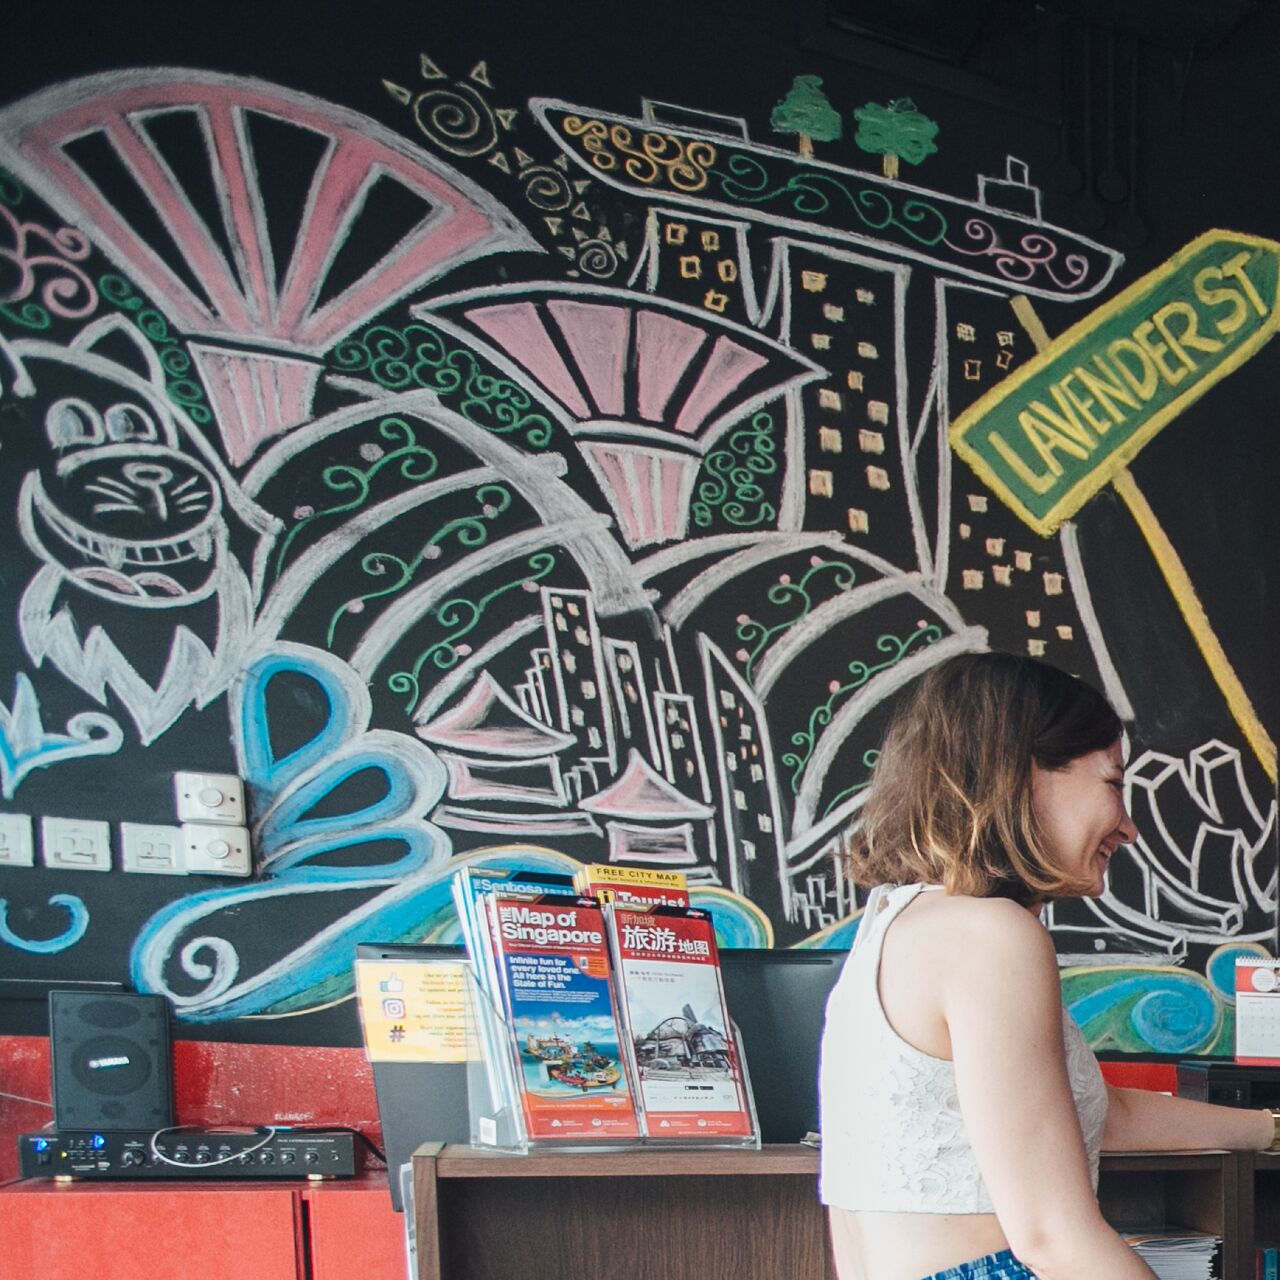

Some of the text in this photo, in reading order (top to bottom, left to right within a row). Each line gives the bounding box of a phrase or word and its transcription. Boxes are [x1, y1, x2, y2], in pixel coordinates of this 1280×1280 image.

[988, 252, 1267, 495] LAVENDER ST
[597, 868, 625, 876] FREE
[629, 871, 652, 879] CITY
[481, 879, 543, 893] Sentosa
[512, 908, 555, 927] Map
[557, 911, 577, 927] of
[502, 923, 602, 945] Singapore
[622, 925, 710, 956] 旅游地图
